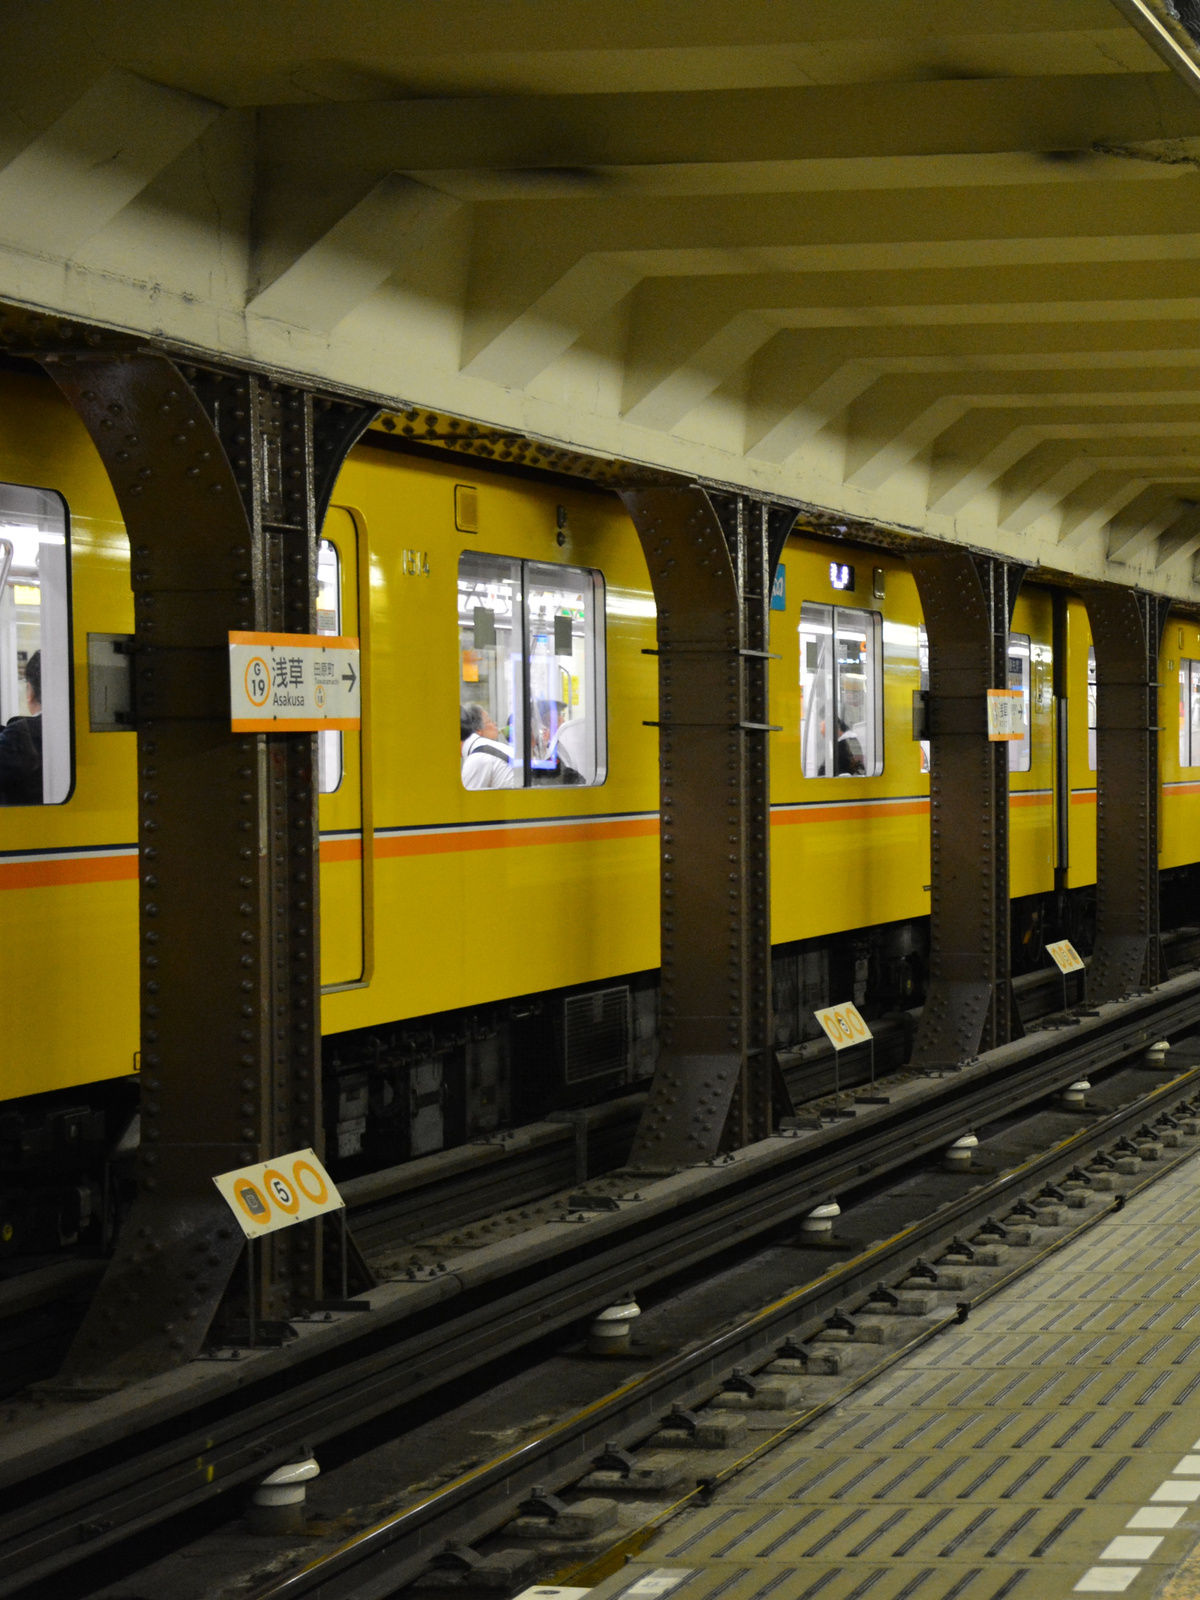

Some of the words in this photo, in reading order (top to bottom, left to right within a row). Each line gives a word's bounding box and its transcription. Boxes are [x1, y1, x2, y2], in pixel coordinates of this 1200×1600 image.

[402, 549, 430, 578] 1514
[254, 662, 261, 676] G
[272, 657, 304, 688] 浅草
[251, 679, 265, 696] 19
[272, 692, 305, 706] Asakusa
[273, 1181, 291, 1203] 5
